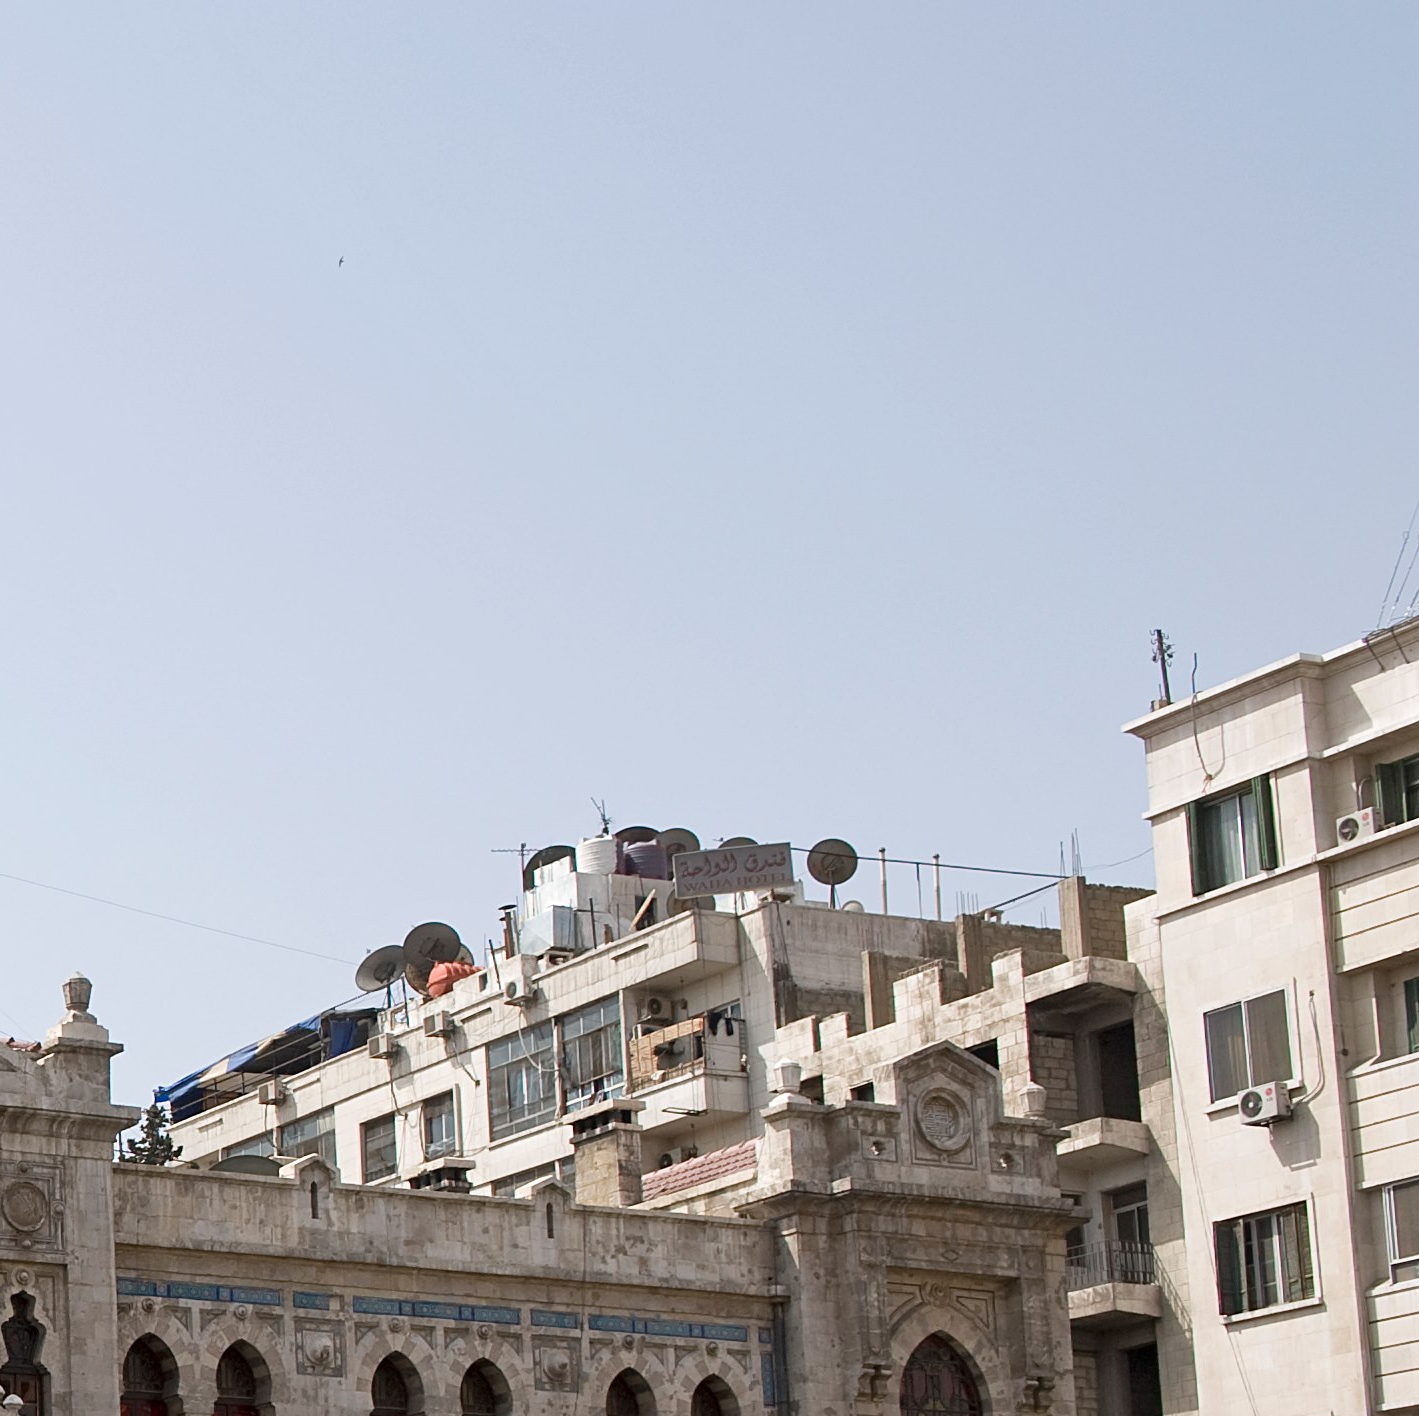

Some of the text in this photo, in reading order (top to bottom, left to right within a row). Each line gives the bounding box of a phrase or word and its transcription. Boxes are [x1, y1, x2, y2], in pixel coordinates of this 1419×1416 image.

[681, 851, 787, 878] فندق الواحة
[683, 872, 788, 893] WAHA HOTEL
